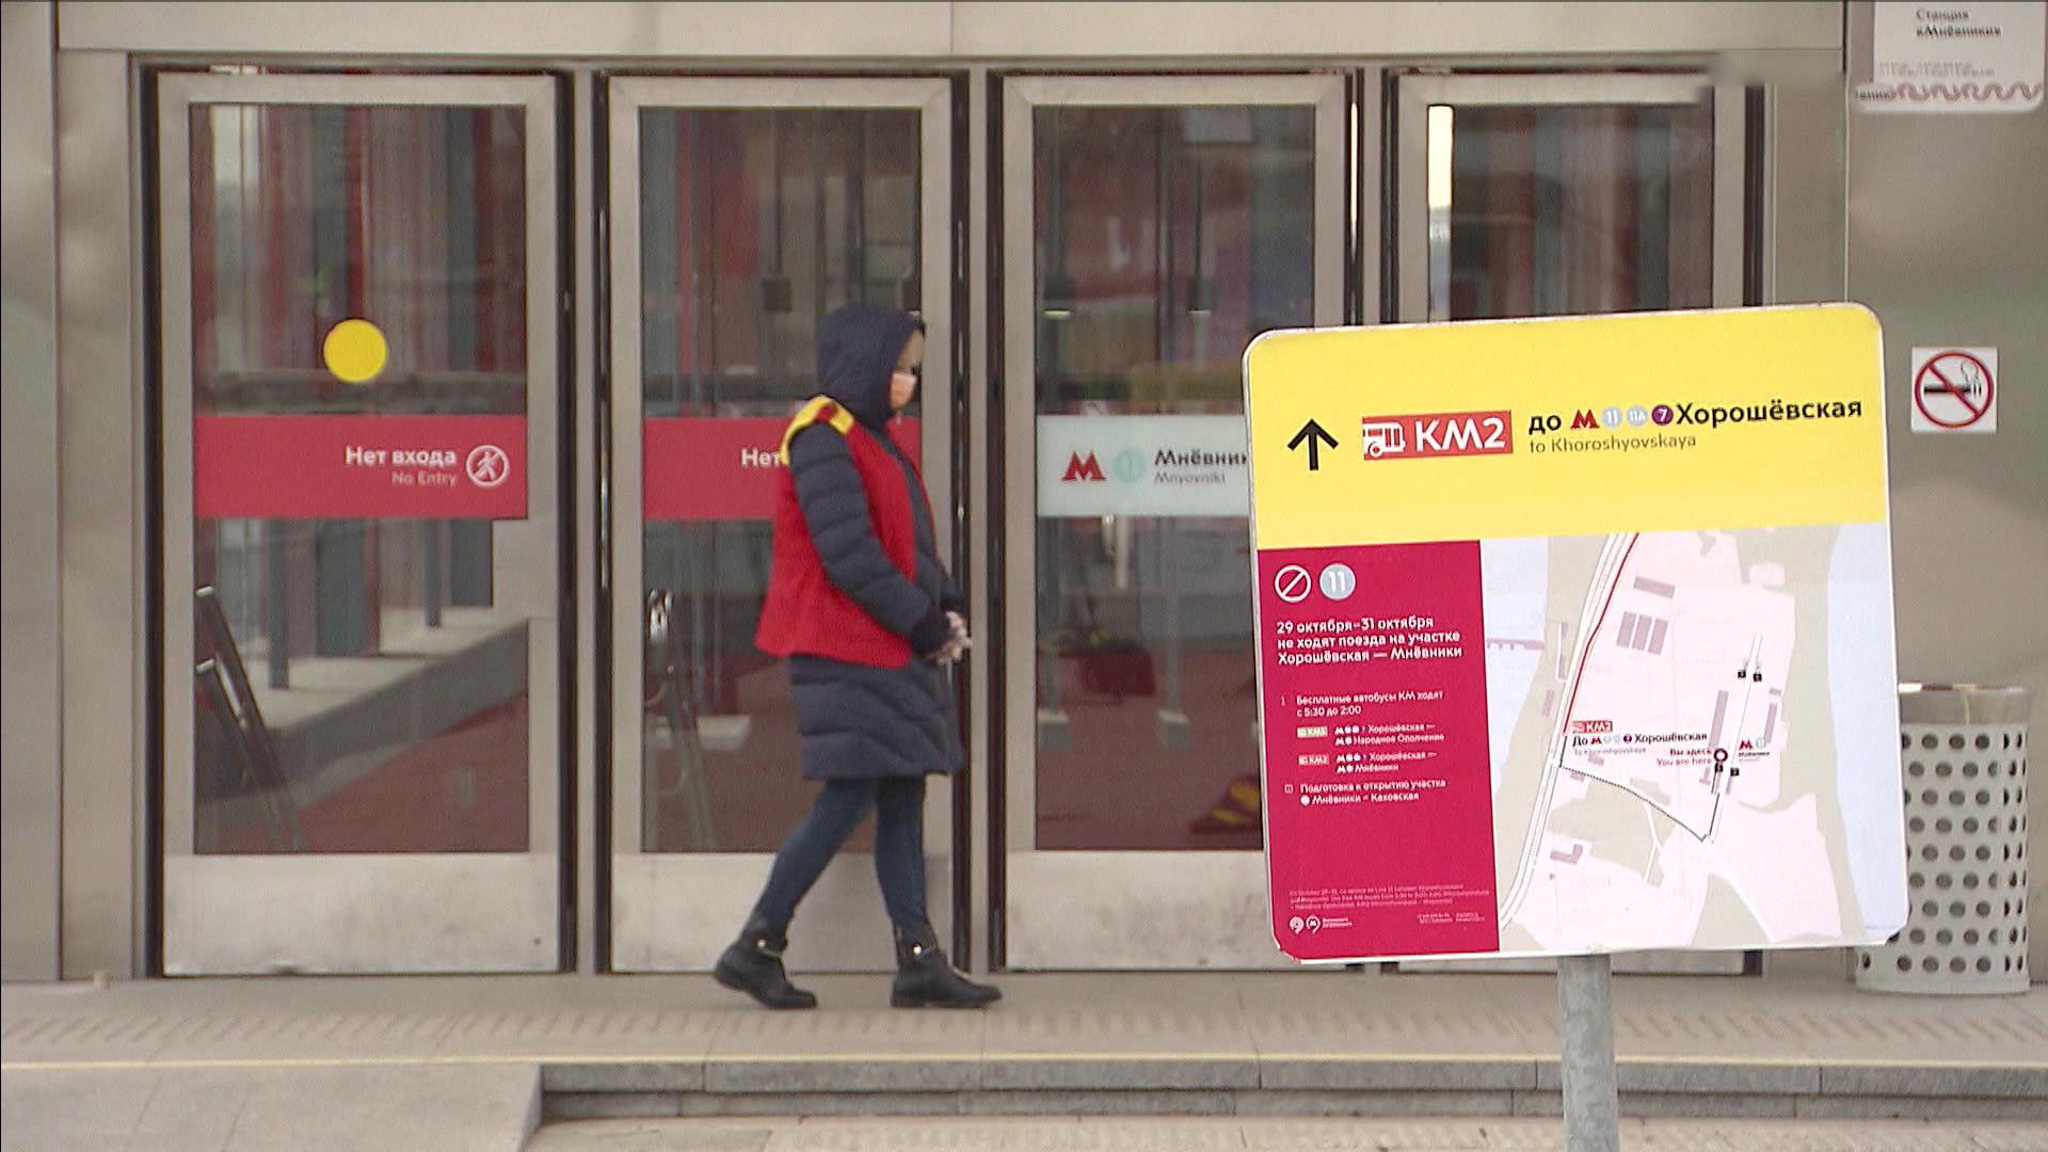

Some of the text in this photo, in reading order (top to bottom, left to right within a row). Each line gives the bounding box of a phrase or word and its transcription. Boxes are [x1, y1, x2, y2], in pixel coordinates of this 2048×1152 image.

[1529, 414, 1562, 434] до
[1676, 399, 1862, 428] Хорошёвская
[1530, 433, 1697, 454] to Khoroshyovskaya
[344, 445, 457, 467] Нет входа
[392, 471, 458, 486] No Entry
[1328, 570, 1346, 592] 11
[1276, 621, 1294, 634] 29
[1378, 614, 1434, 630] октября
[1277, 630, 1460, 650] не ходят поезда на участке
[1278, 650, 1369, 666] Хорошёвская
[1390, 647, 1462, 660] Мнёвники
[1296, 690, 1443, 705] Бесплатные автобусы КМ ходят
[1297, 704, 1362, 717] с 5:30 до 2:00
[1572, 735, 1588, 747] До
[1634, 732, 1707, 745] Хорошёвская
[1300, 782, 1354, 793] Подготовка
[1363, 780, 1410, 791] открытию
[1411, 779, 1446, 790] участка
[1311, 794, 1361, 805] Мнёвники
[1370, 792, 1419, 802] Каховская
